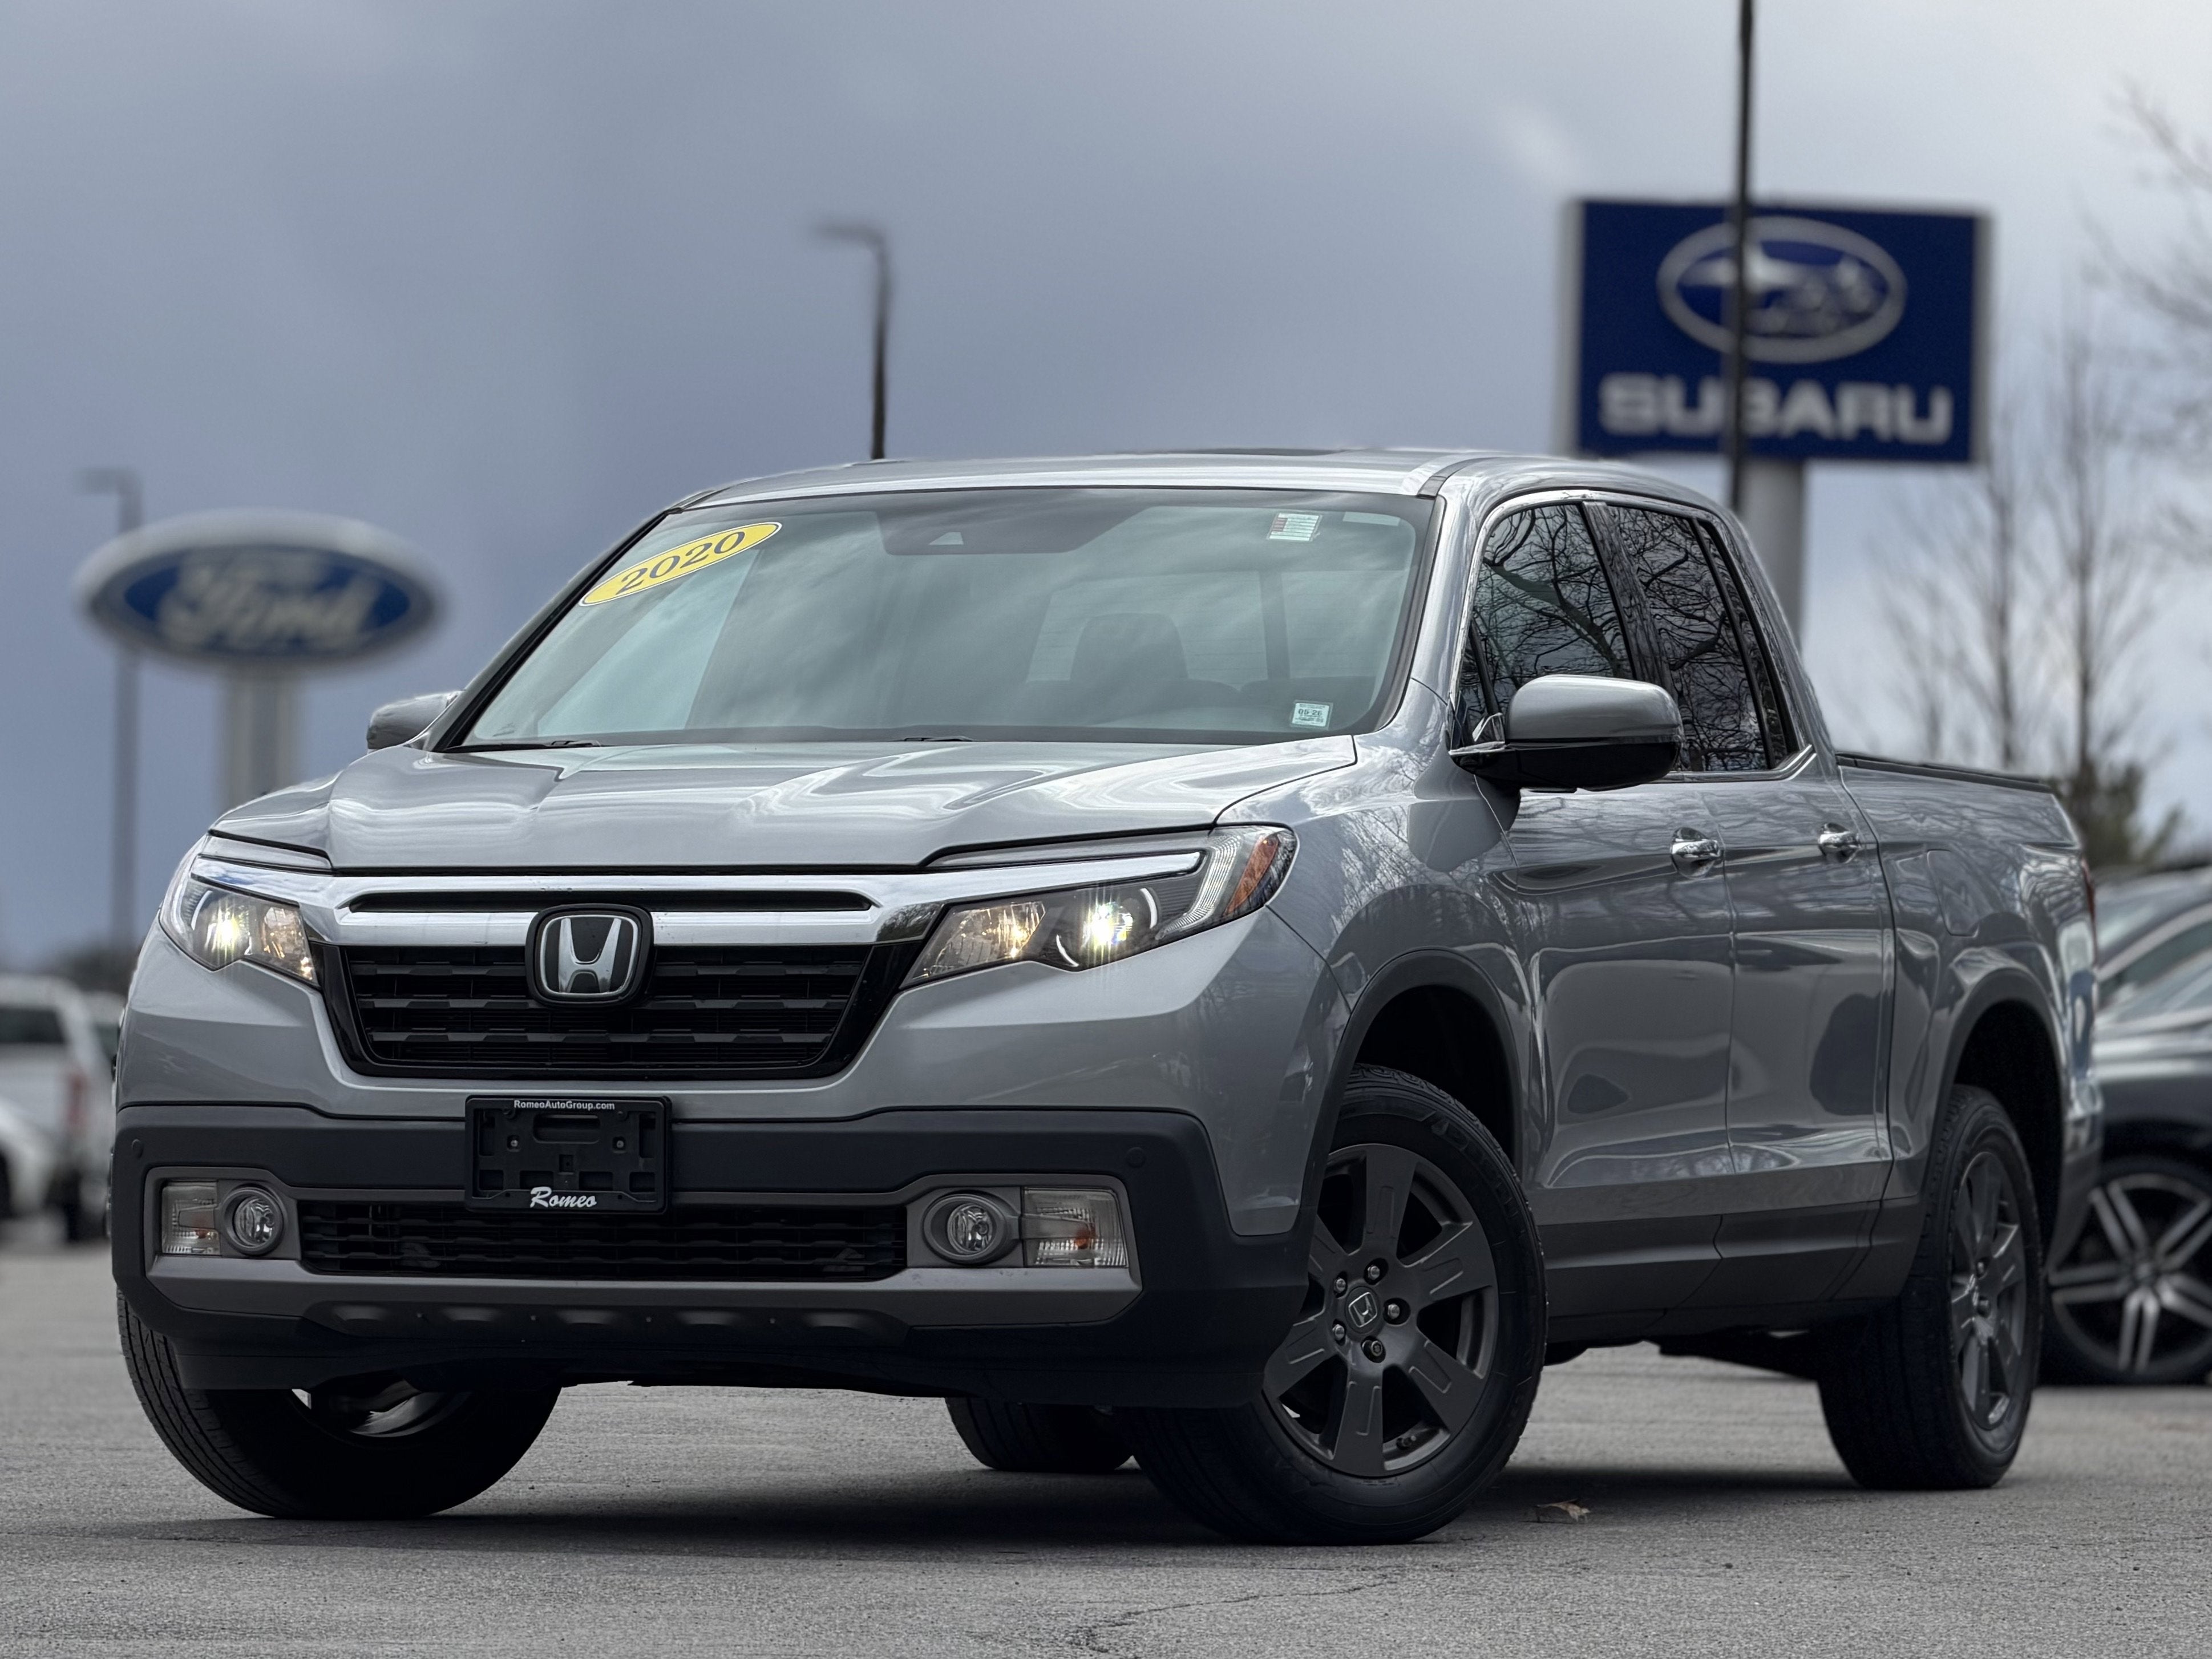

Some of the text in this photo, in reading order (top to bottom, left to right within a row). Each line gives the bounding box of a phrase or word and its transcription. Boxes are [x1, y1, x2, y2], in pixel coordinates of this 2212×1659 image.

[1601, 373, 1953, 444] SUBARU
[616, 532, 745, 595] 2020
[514, 1100, 615, 1111] RomeoAutoGroup.com
[530, 1186, 597, 1208] Romeo
